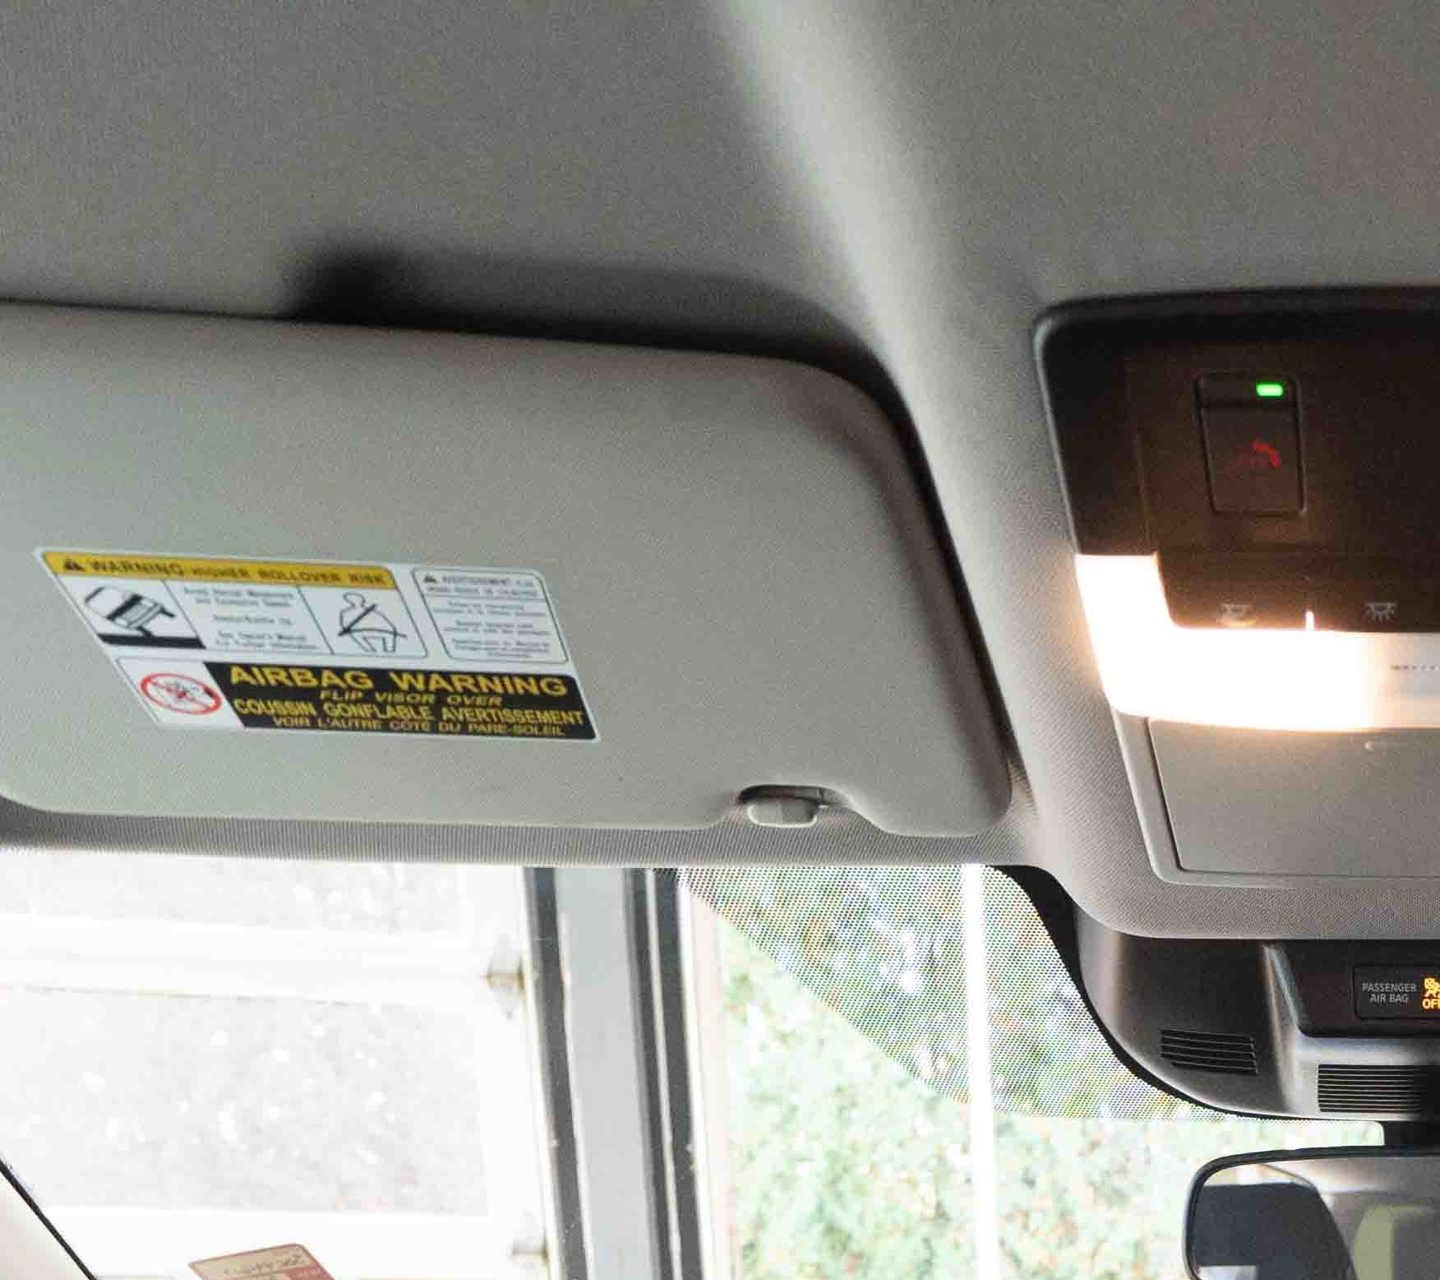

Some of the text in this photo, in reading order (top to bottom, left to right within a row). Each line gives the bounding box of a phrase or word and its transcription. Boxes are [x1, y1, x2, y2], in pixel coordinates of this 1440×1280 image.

[229, 665, 568, 697] AIRBAG WARNING
[446, 694, 503, 706] OVER
[441, 707, 584, 726] AVERTISSEMENT
[1361, 982, 1417, 993] PASSENGER
